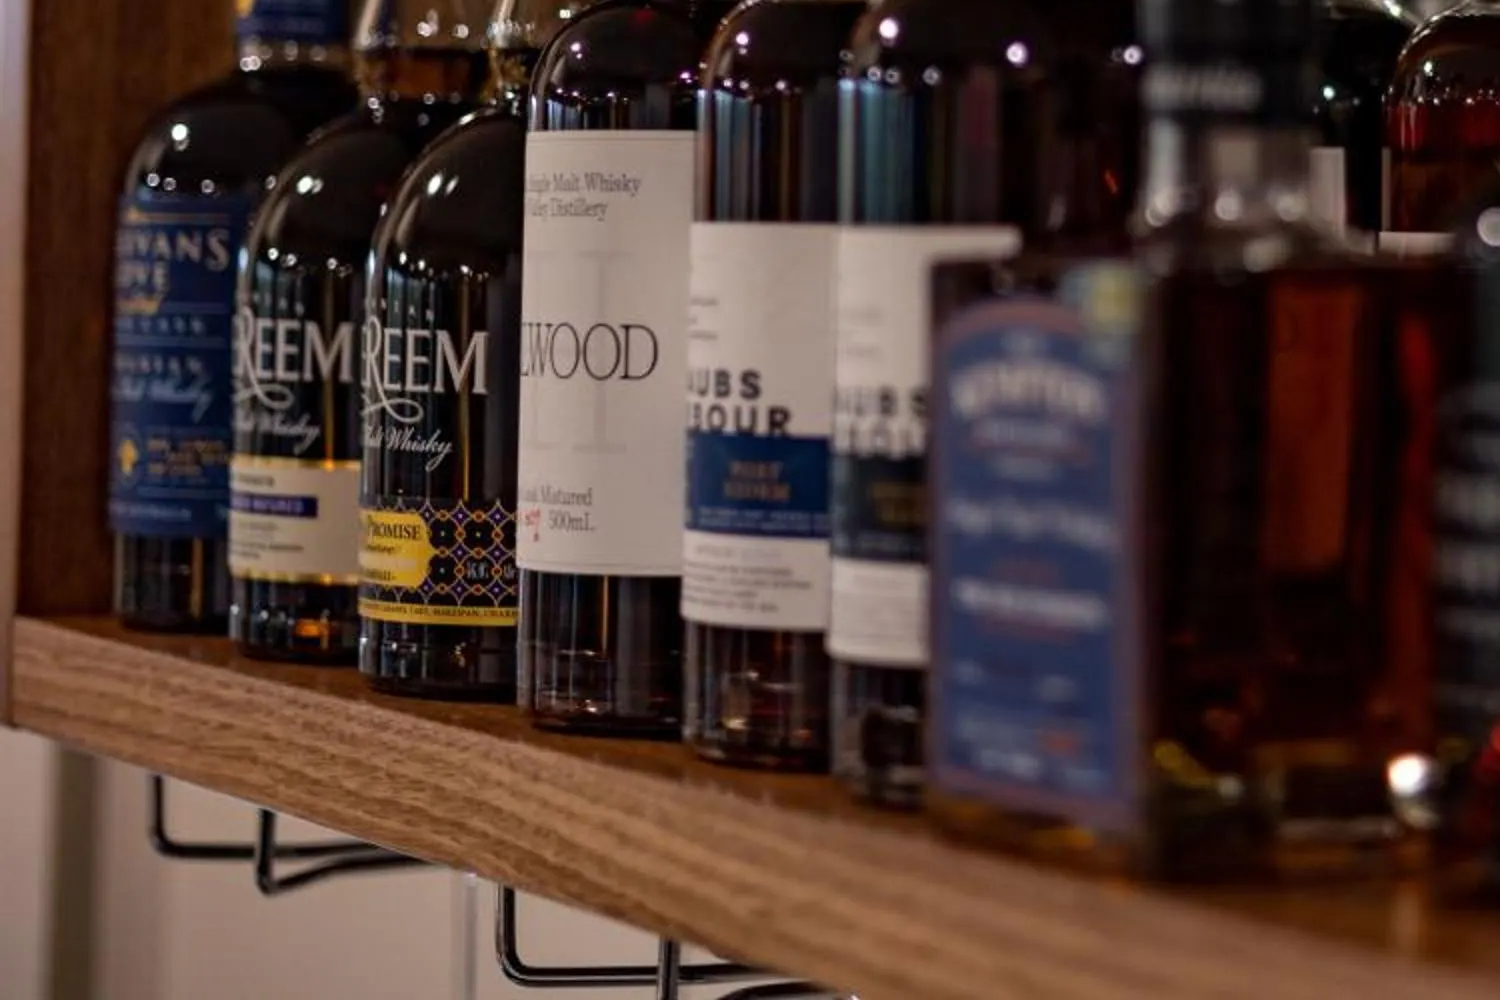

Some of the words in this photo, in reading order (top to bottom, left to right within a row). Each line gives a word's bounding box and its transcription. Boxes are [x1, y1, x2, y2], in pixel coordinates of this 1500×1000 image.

[584, 170, 642, 198] Whisky
[549, 197, 608, 222] Distillery
[361, 315, 490, 424] REEM
[386, 426, 453, 473] Whisky
[541, 484, 593, 507] Matured
